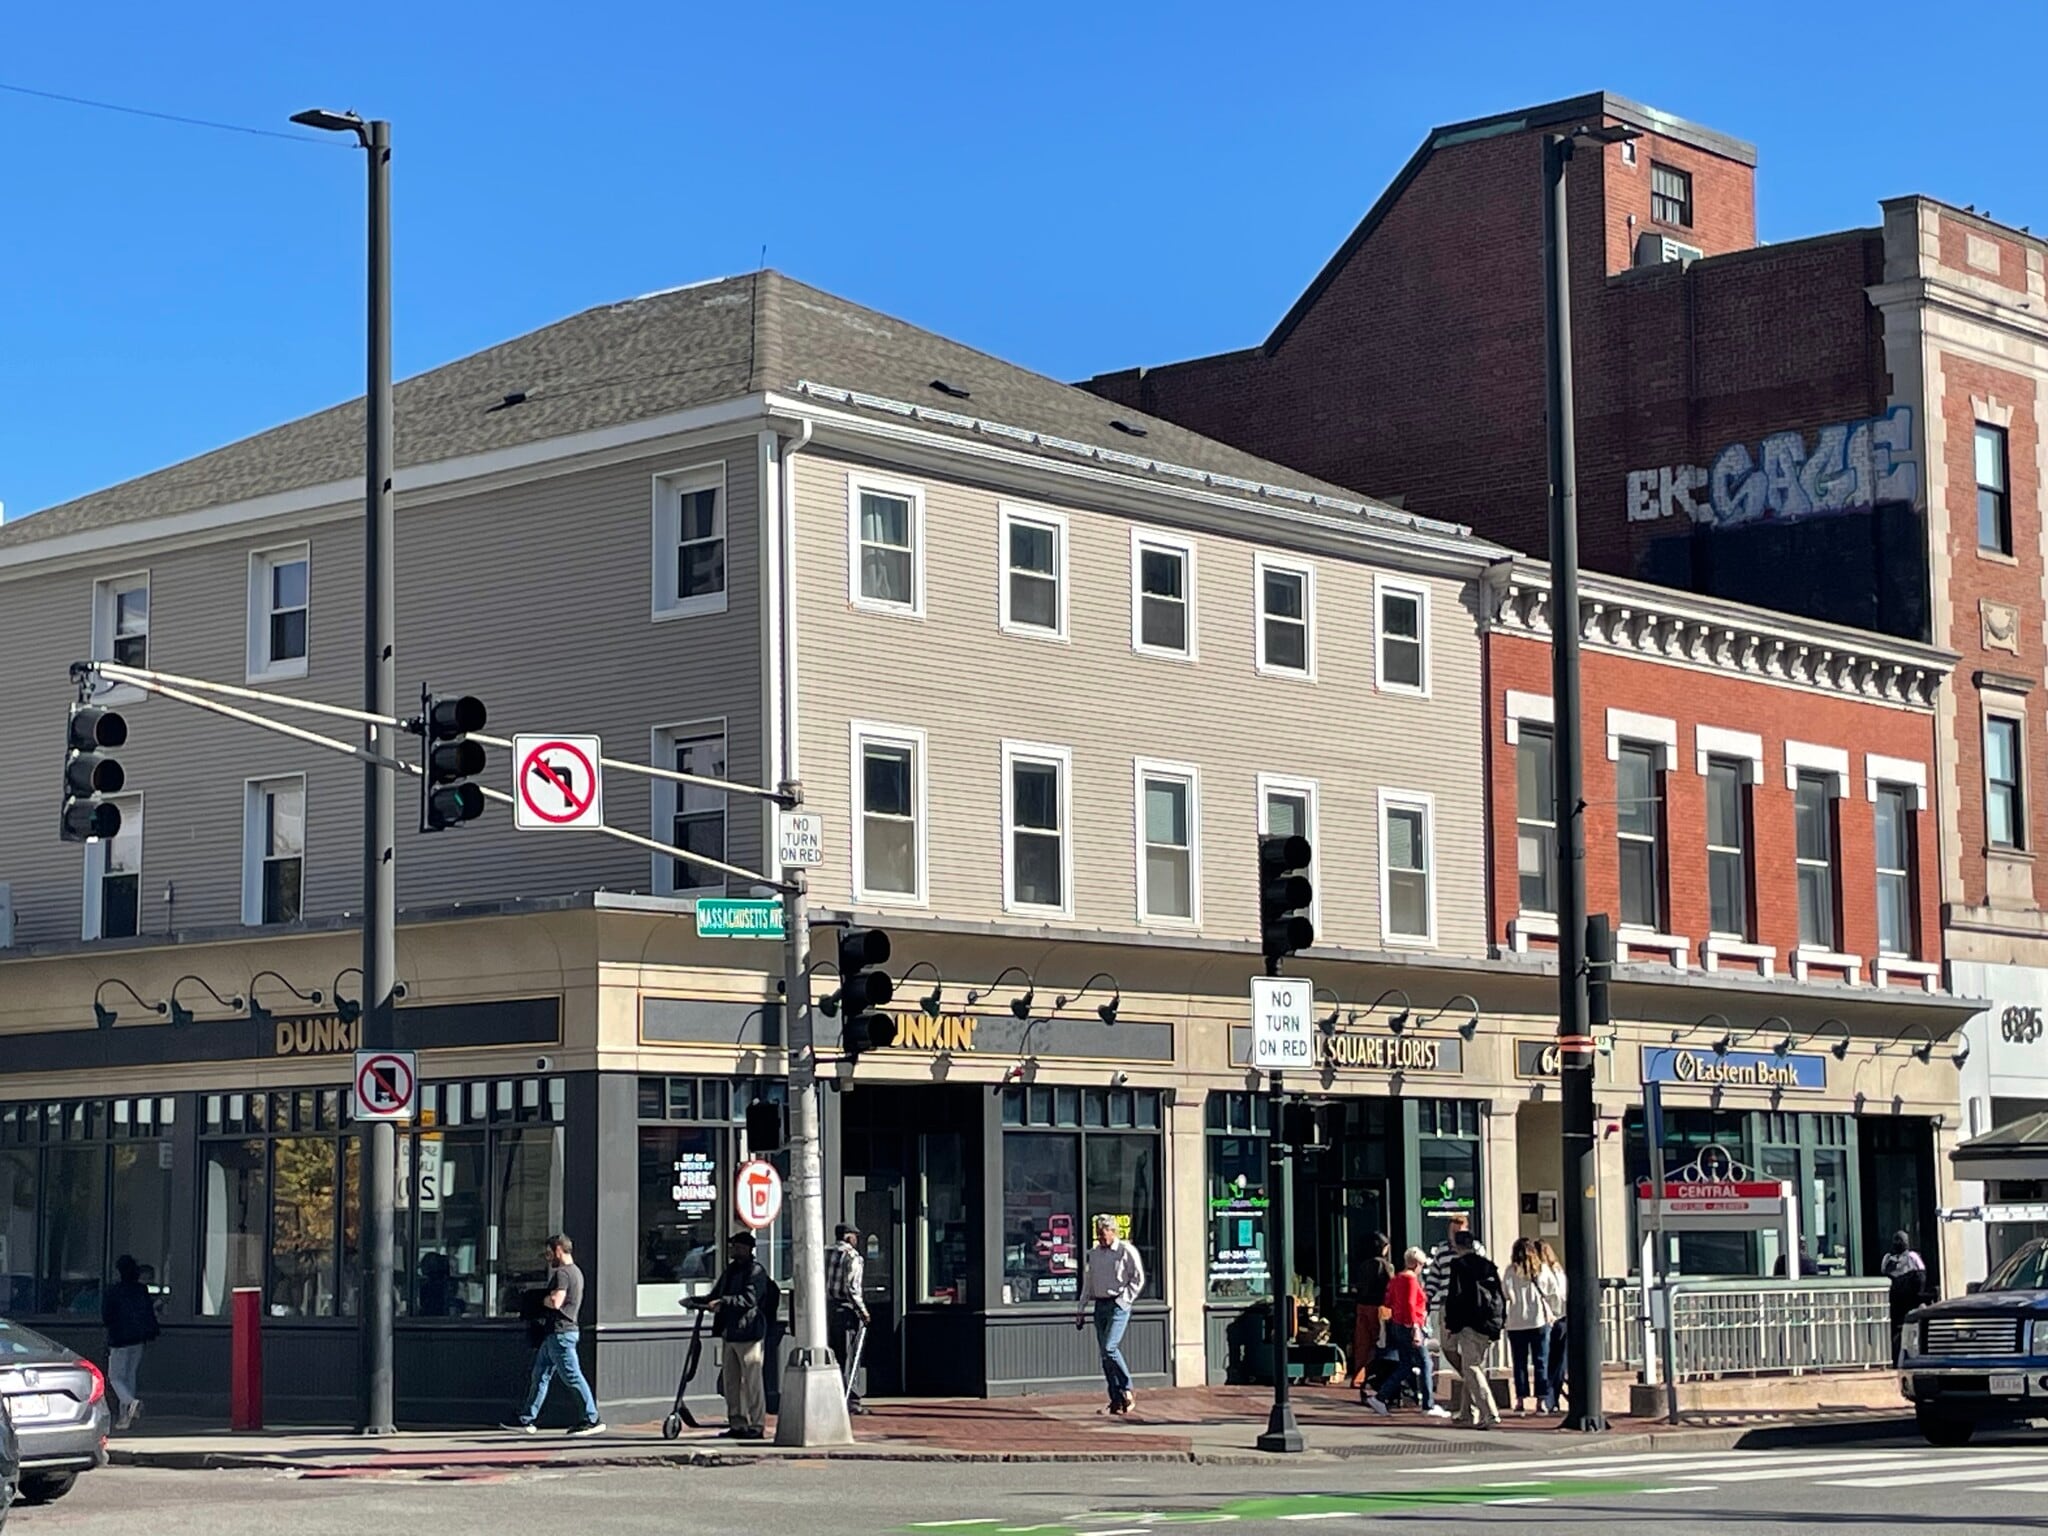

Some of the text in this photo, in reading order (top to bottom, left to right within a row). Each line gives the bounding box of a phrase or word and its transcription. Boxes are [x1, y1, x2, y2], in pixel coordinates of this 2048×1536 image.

[793, 817, 809, 831] NO
[785, 832, 818, 846] TURN
[781, 847, 822, 862] ON RED
[699, 908, 768, 929] MASSACHUSETTS
[1271, 991, 1292, 1007] NO
[1266, 1015, 1300, 1032] TURN
[1259, 1039, 1277, 1056] ON
[1282, 1040, 1307, 1057] RED
[1328, 1035, 1384, 1065] SQUARE
[1387, 1037, 1441, 1068] FLORIST
[1697, 1058, 1800, 1085] Eastern Bank
[679, 1171, 711, 1186] FREE
[672, 1185, 717, 1201] DRINKS
[1678, 1185, 1739, 1198] CENTRAL
